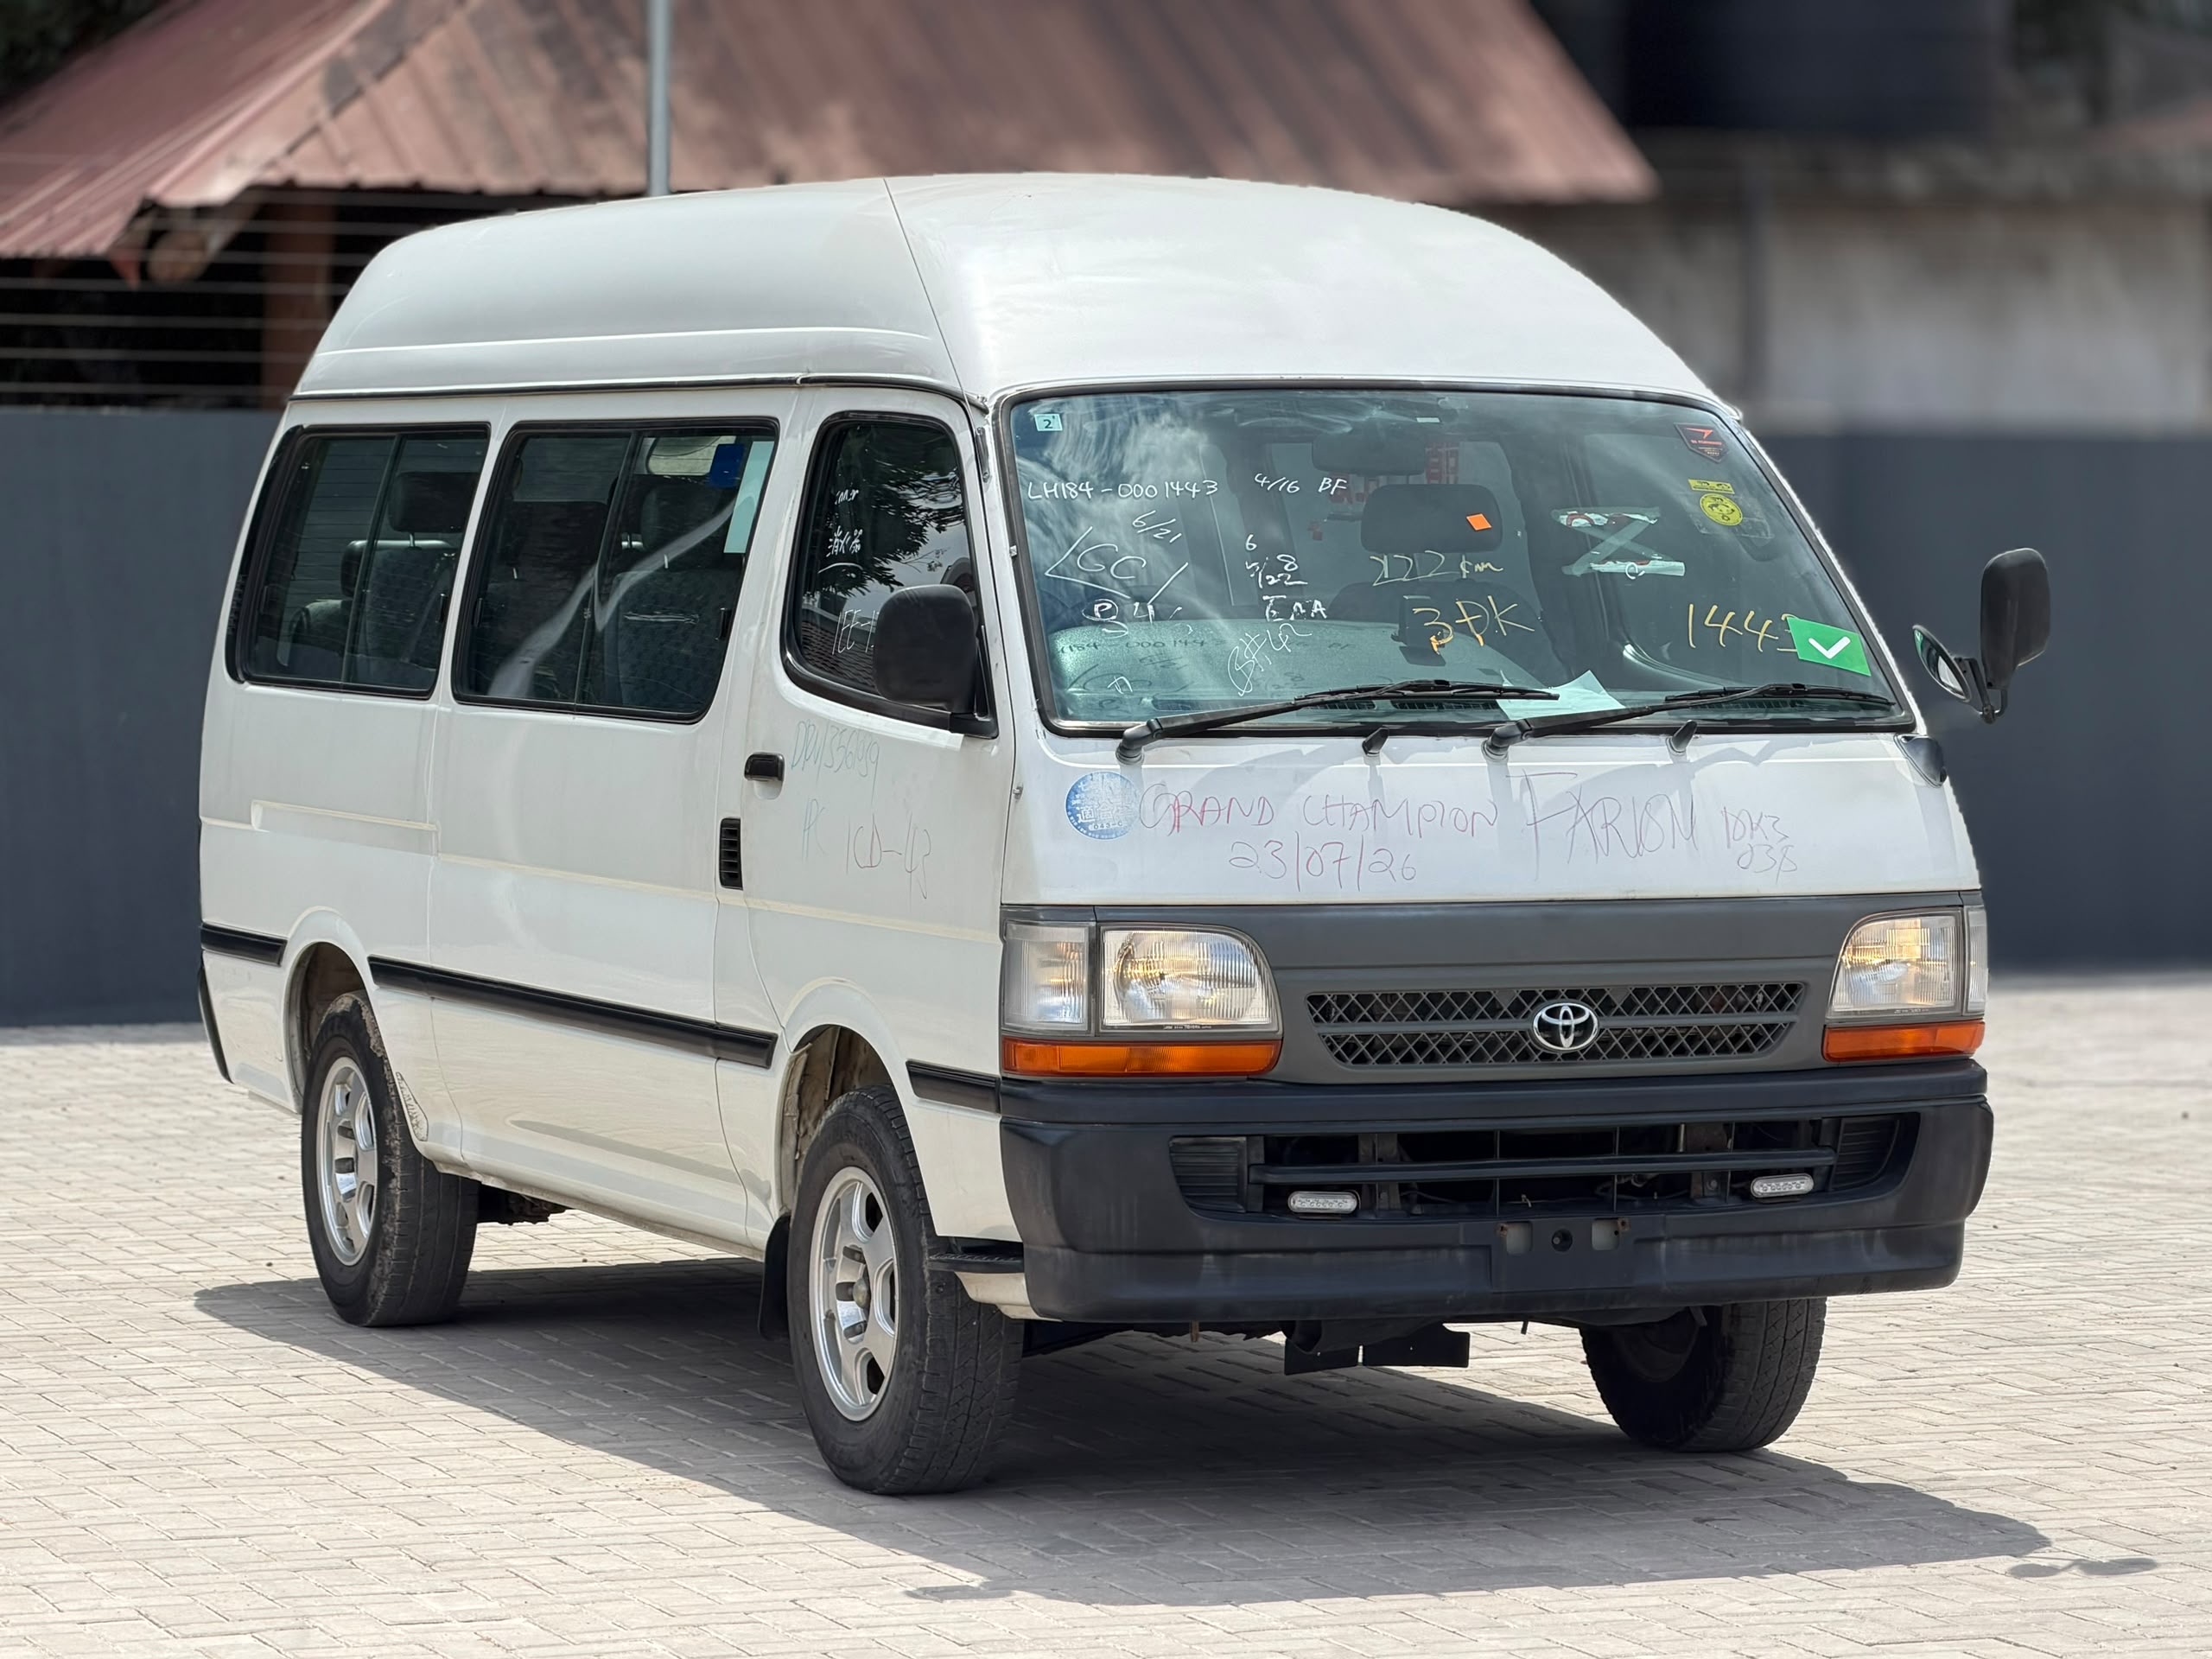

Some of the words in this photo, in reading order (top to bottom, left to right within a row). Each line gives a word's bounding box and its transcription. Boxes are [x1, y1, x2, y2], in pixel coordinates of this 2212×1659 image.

[1318, 477, 1348, 496] BF
[1138, 782, 1275, 837] GRAND
[1302, 793, 1500, 838] CHAMPION
[1228, 830, 1417, 893] 23/07/26
